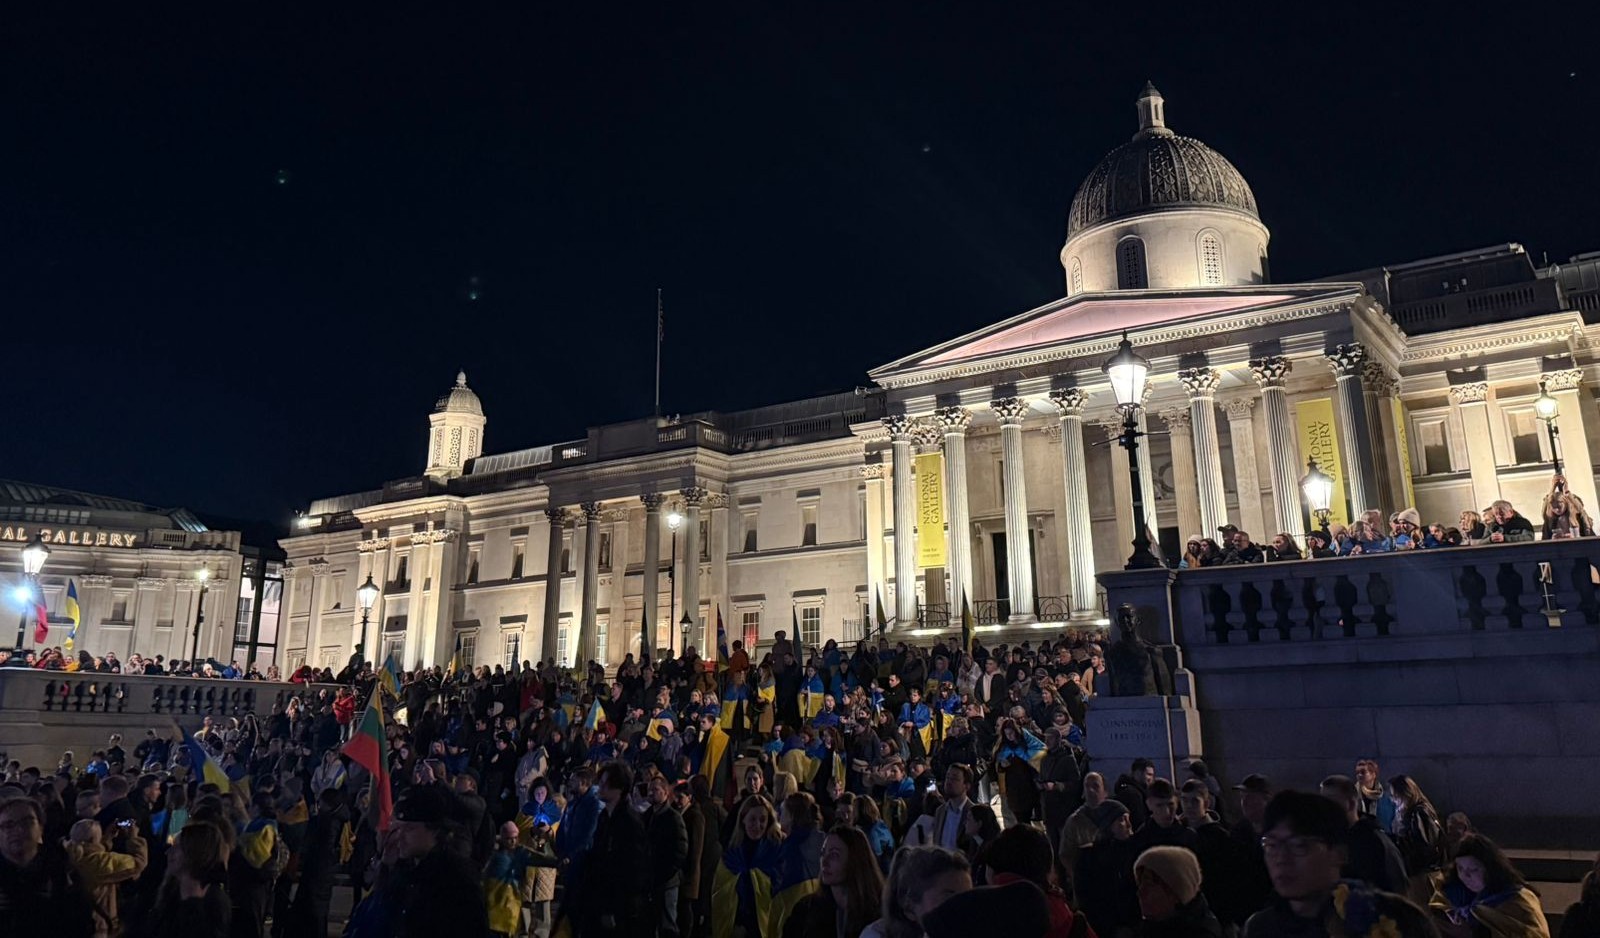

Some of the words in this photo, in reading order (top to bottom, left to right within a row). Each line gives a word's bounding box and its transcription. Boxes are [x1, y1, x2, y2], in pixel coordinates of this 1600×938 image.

[922, 473, 930, 524] NATIONAL
[930, 472, 939, 524] GALLERY
[0, 526, 28, 541] AL
[40, 528, 137, 547] GALLERY
